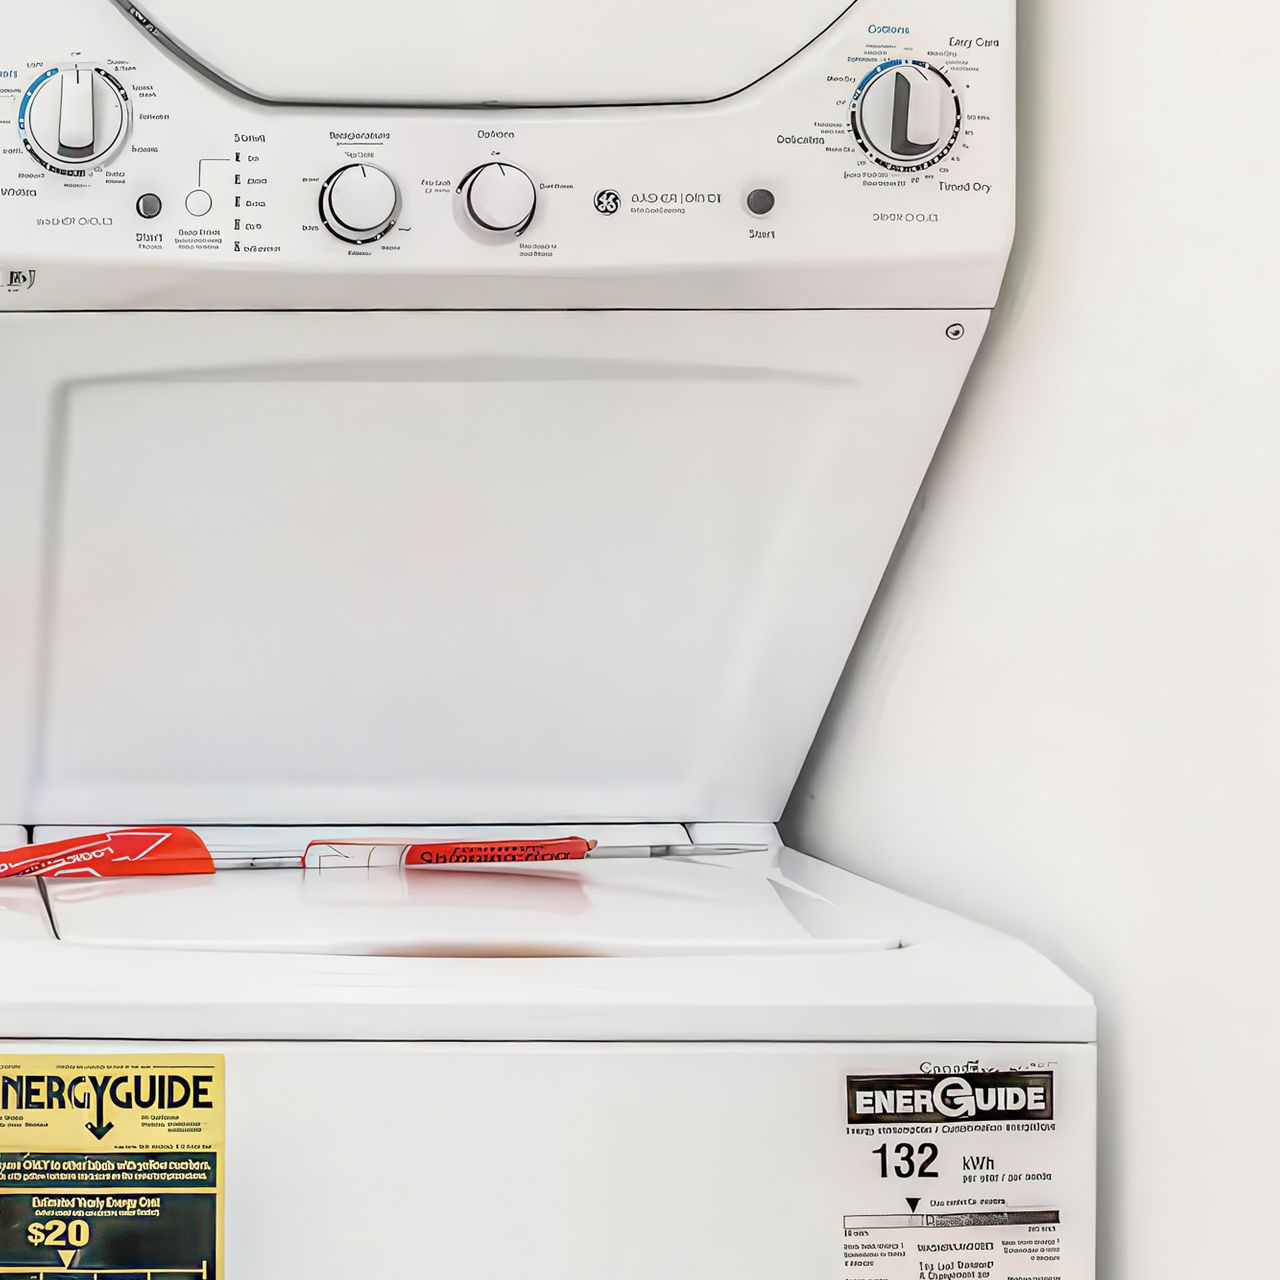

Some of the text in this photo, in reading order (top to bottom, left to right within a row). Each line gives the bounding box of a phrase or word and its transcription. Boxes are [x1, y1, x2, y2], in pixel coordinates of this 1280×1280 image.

[855, 1076, 1046, 1118] ENERGUIDE
[871, 1142, 939, 1178] 132
[962, 1156, 995, 1171] kWh
[27, 1219, 90, 1246] $20
